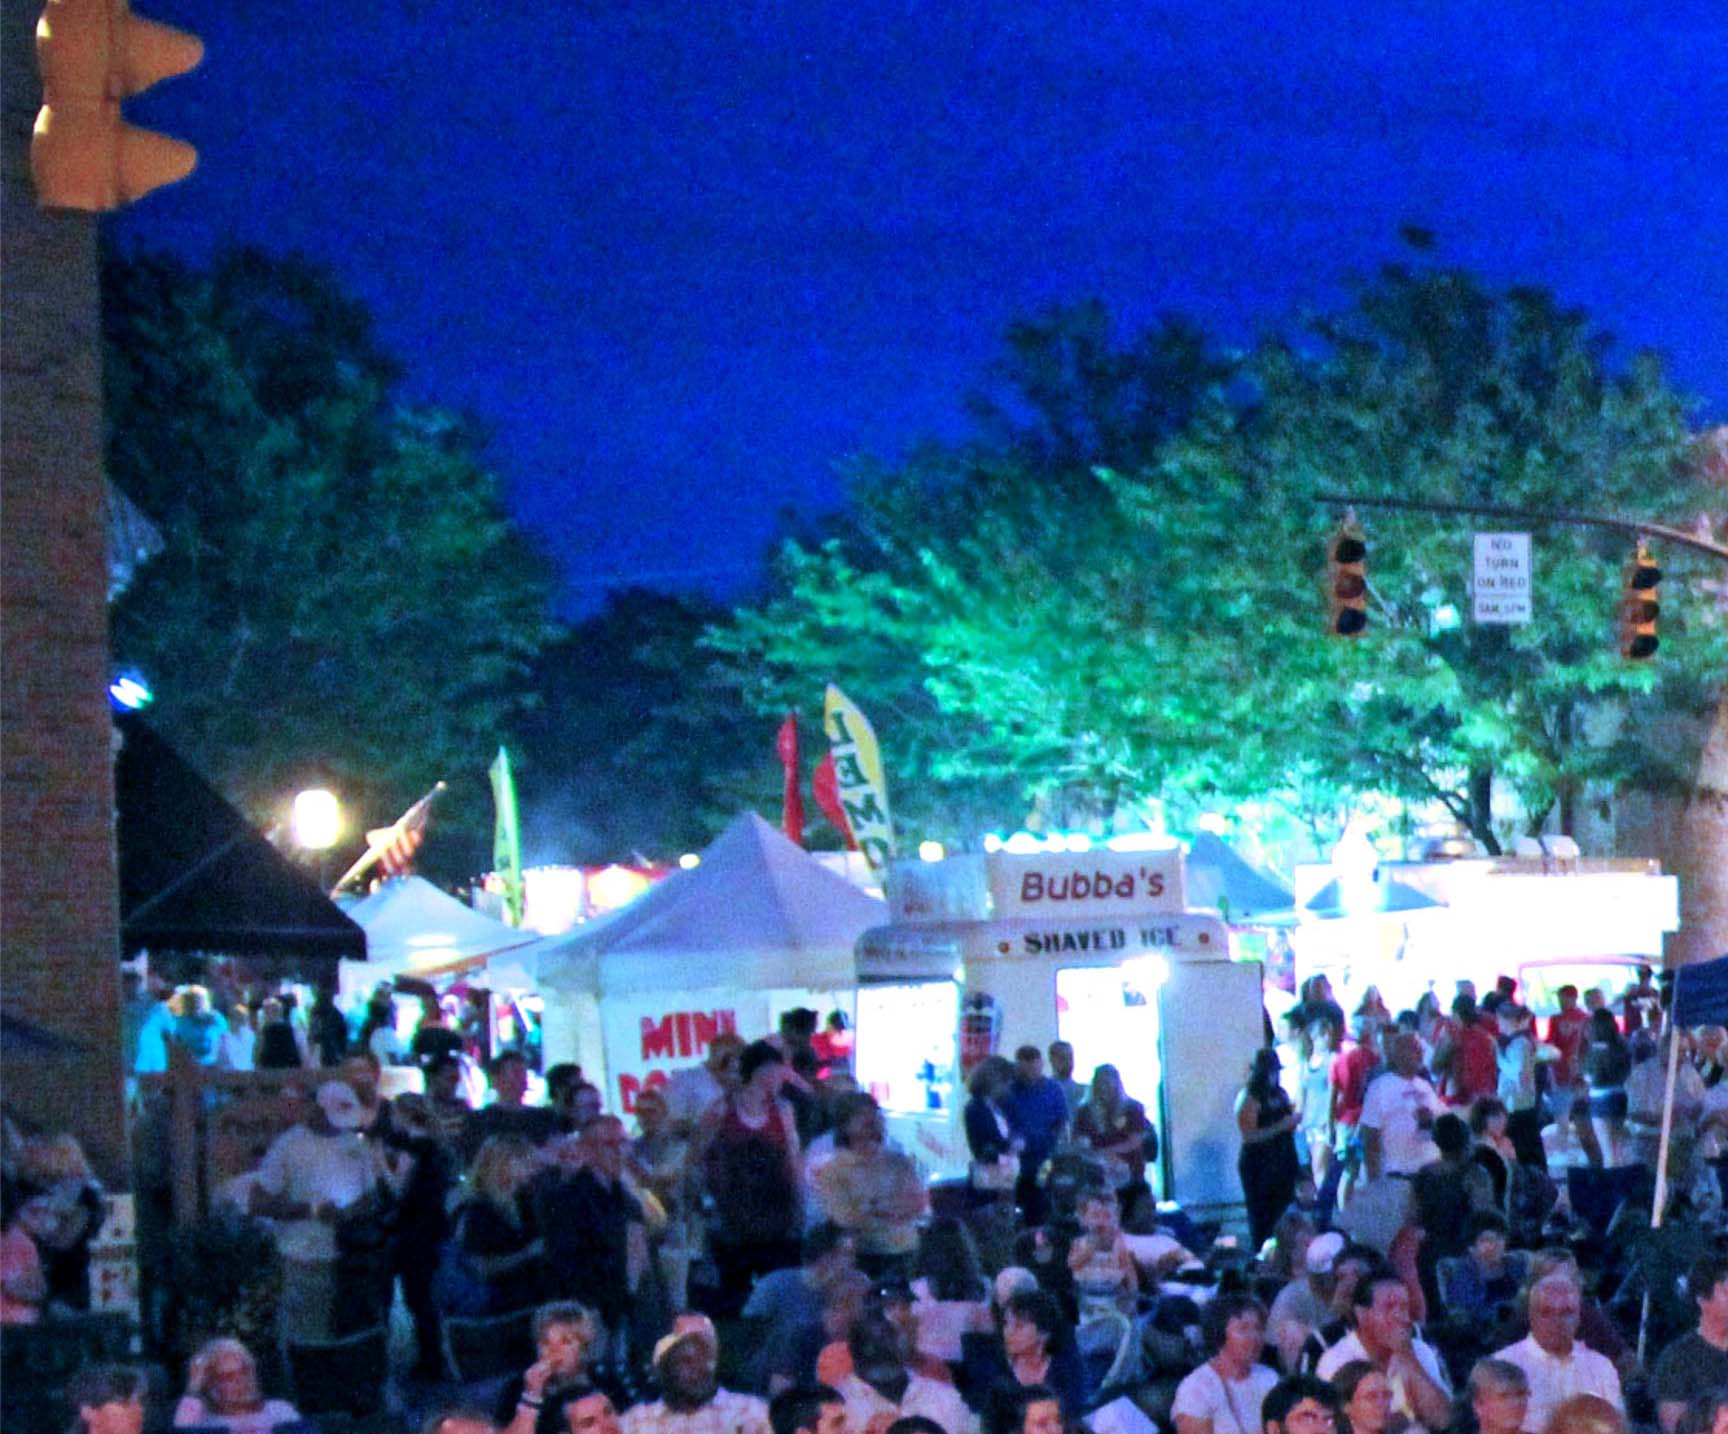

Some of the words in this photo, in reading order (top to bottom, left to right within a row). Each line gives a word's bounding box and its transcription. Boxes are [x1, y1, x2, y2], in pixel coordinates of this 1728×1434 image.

[1491, 539, 1513, 550] NO
[1485, 557, 1519, 570] TURN
[1477, 576, 1495, 589] ON
[1500, 576, 1526, 590] RED
[831, 711, 889, 870] LEMO
[1020, 867, 1164, 901] Bubba's
[1024, 930, 1126, 954] SHAVED
[1139, 925, 1181, 949] ICE
[641, 1009, 735, 1061] MINI
